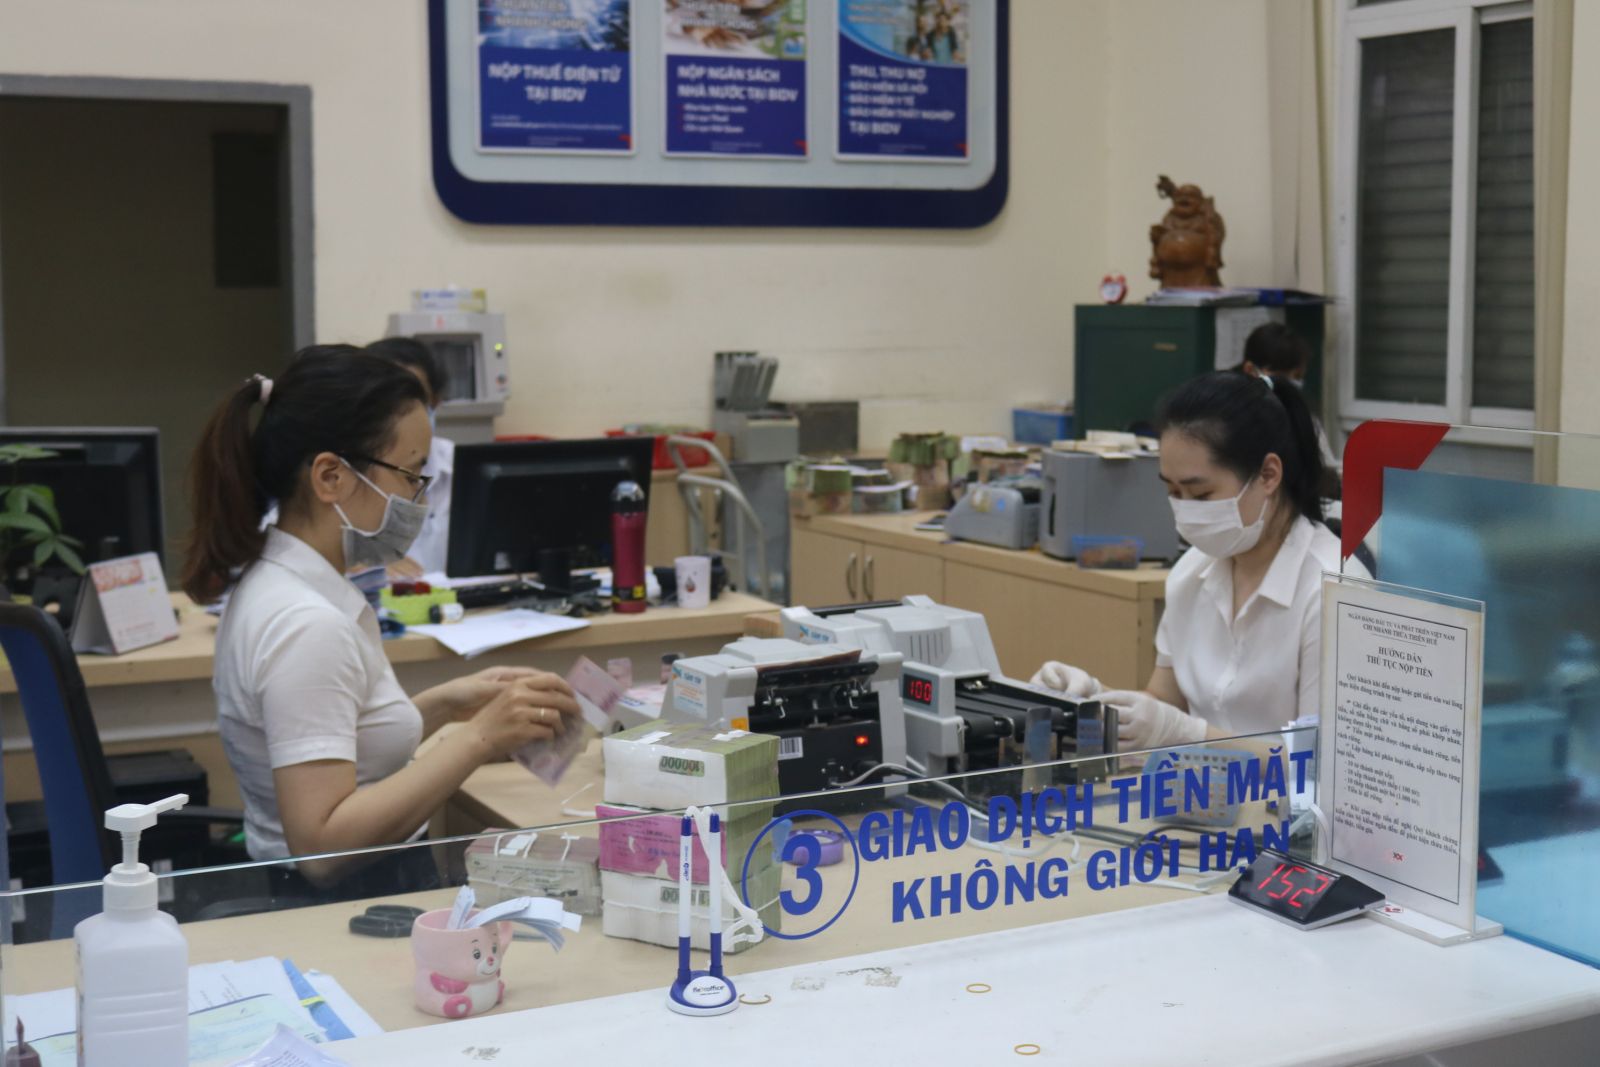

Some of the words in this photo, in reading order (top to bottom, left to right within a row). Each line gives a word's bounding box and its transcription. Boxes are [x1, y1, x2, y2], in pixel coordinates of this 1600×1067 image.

[1378, 645, 1404, 660] HƯỚNG
[1399, 662, 1413, 674] NỘP
[909, 679, 932, 702] 100
[858, 802, 970, 862] GIAO
[990, 781, 1094, 851] DỊCH
[1110, 752, 1210, 820] TIỀN
[1226, 746, 1315, 813] MẶT
[780, 833, 824, 915] 3
[891, 857, 1068, 924] KHÔNG
[1085, 831, 1181, 886] GIỚI
[1199, 820, 1291, 874] HẠN
[1258, 864, 1330, 908] 152
